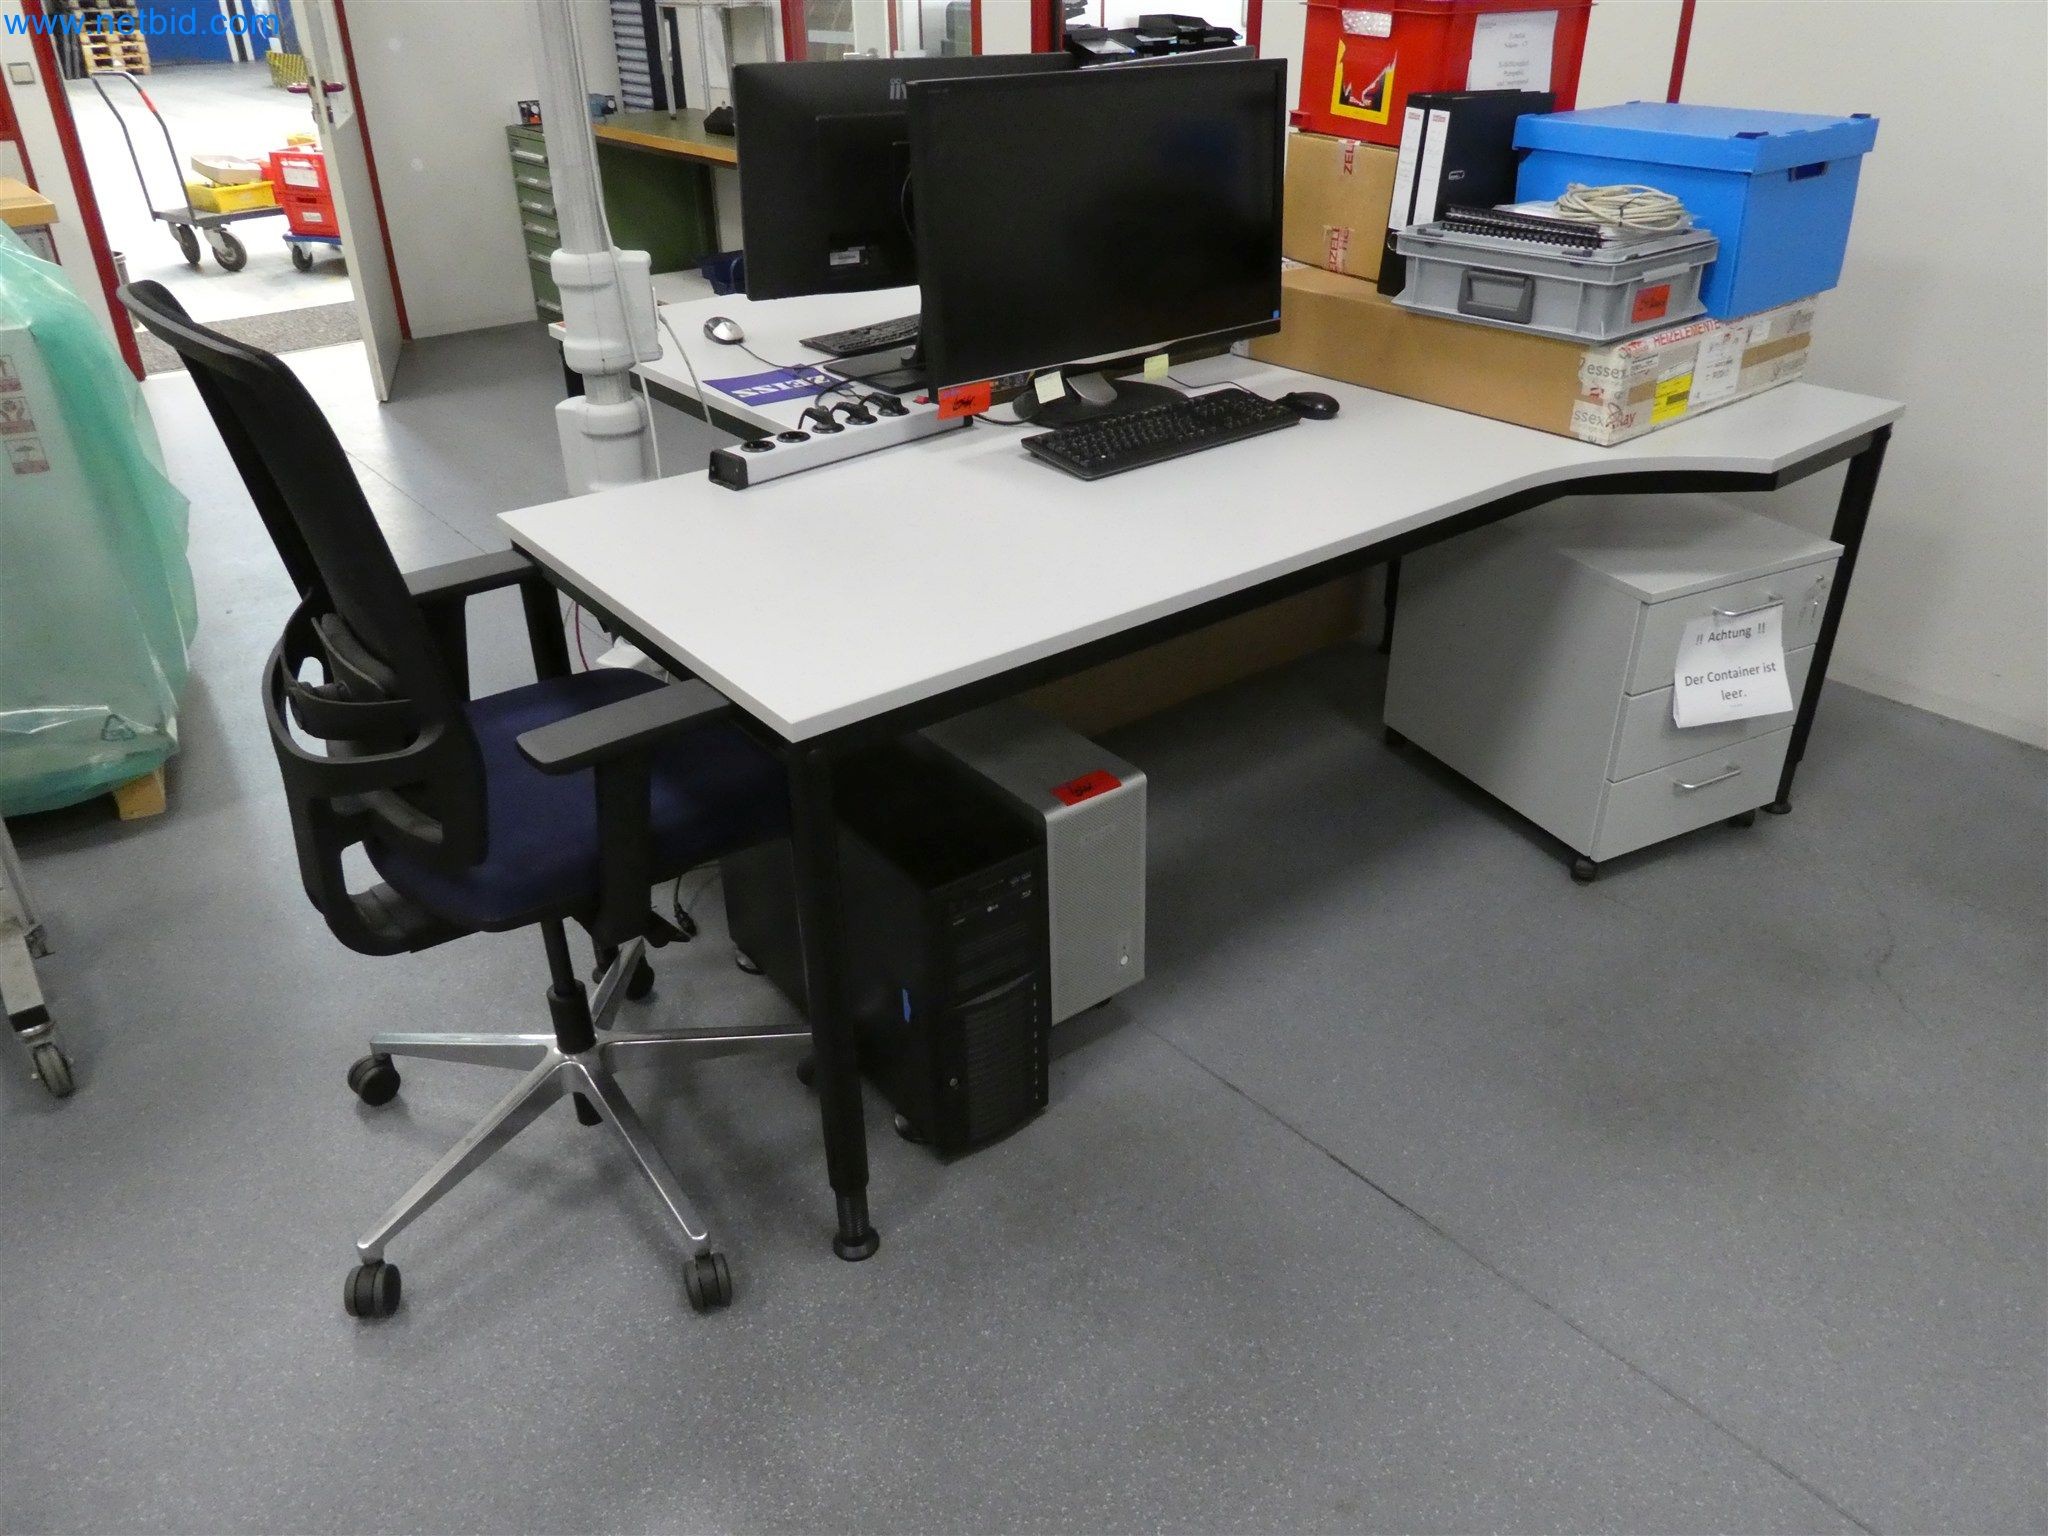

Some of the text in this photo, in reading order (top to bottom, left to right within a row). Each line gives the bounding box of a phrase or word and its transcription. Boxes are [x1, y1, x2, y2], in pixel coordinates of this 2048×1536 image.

[1707, 627, 1752, 643] Achtung
[1684, 662, 1777, 687] Der Container ist
[1721, 689, 1747, 701] leer.
